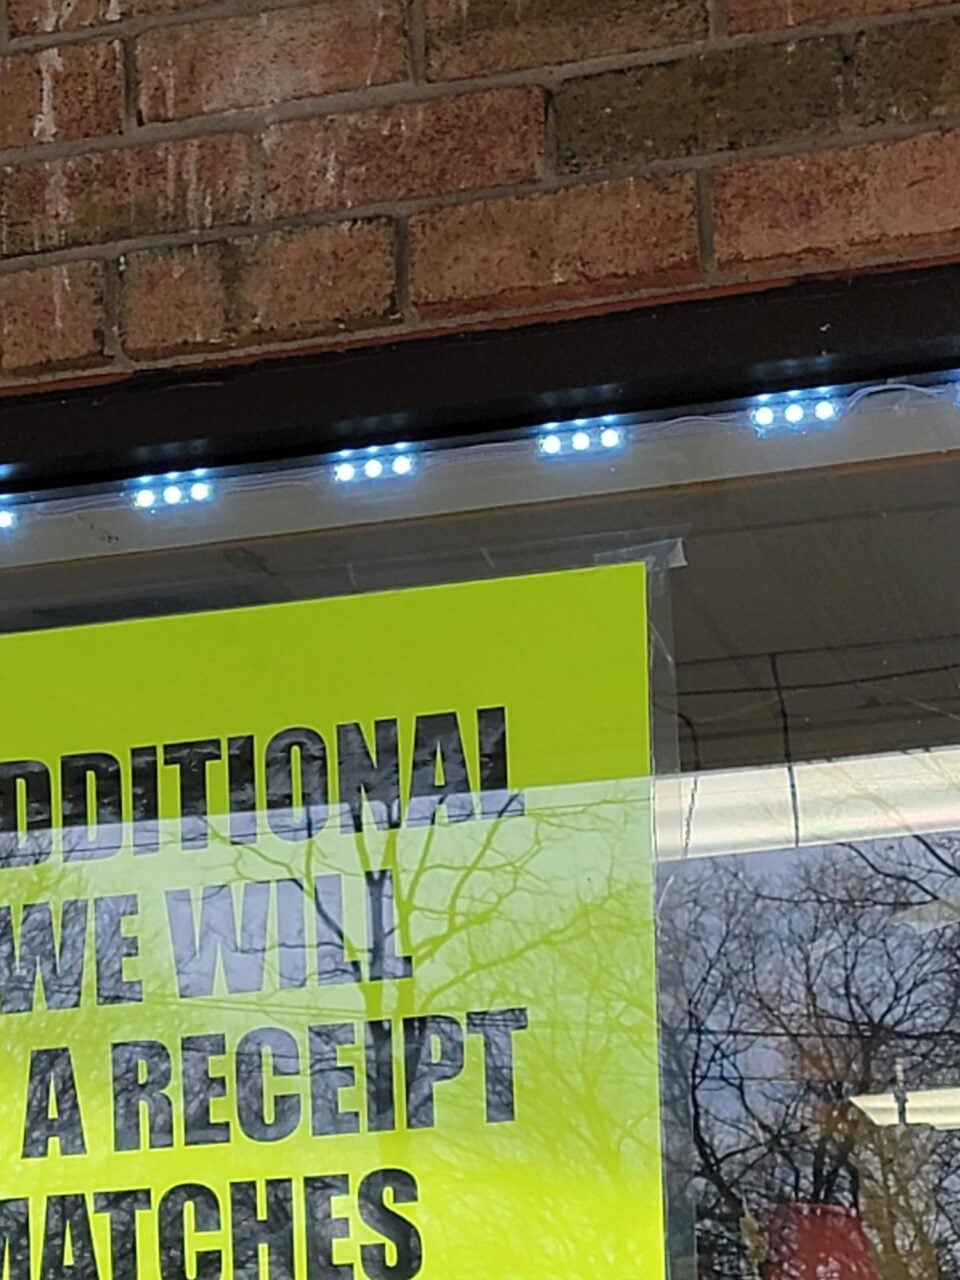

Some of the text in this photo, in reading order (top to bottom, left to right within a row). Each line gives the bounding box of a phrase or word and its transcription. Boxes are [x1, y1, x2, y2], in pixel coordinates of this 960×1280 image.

[165, 866, 414, 999] WILL
[23, 1046, 87, 1159] A
[112, 1008, 528, 1151] RECEIPT
